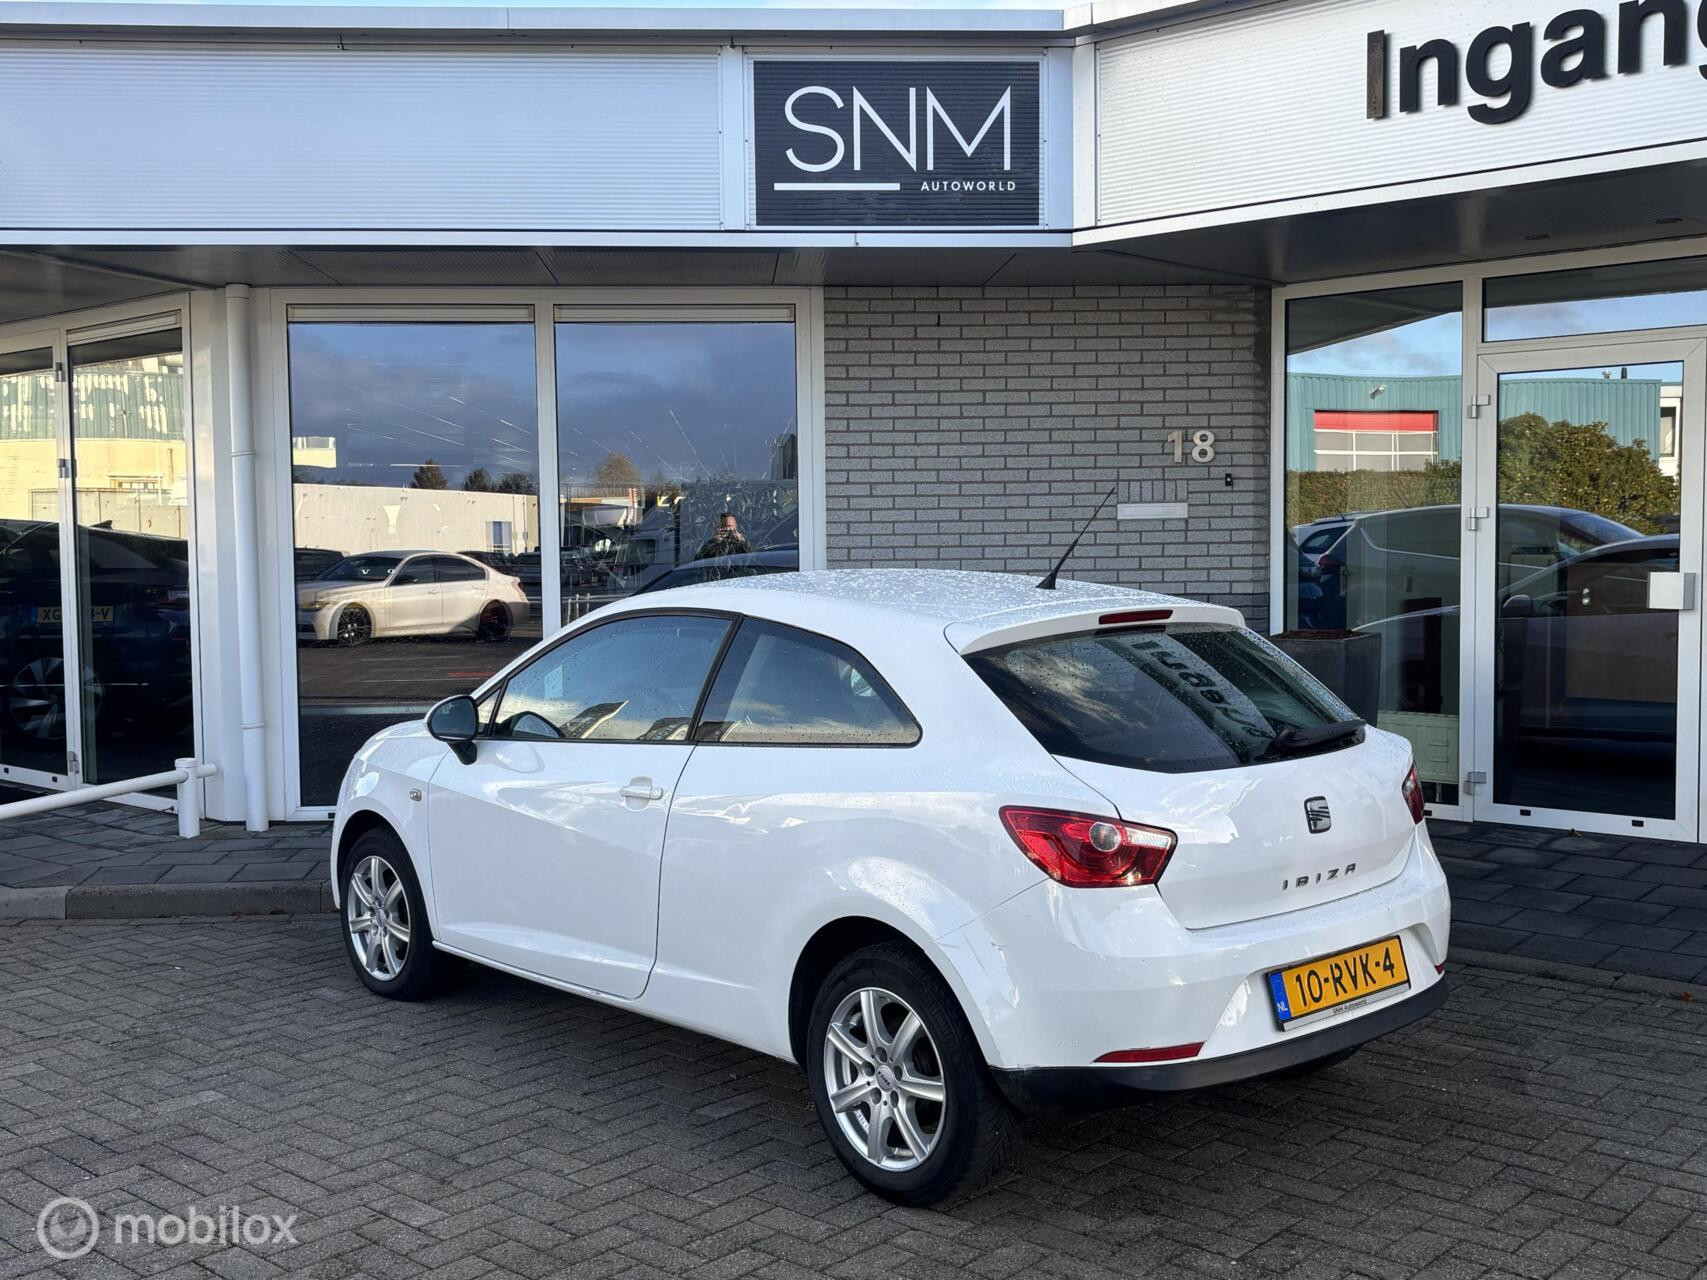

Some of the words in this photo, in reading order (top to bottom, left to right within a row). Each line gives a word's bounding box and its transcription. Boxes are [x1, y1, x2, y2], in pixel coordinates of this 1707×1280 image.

[1366, 0, 1707, 125] Ingan
[784, 85, 1011, 172] SNM
[920, 181, 1016, 191] AUTOWORLD
[1168, 430, 1215, 464] 18
[1282, 863, 1356, 890] IBIZA
[1295, 947, 1395, 1007] 10-RVK-4
[1277, 1001, 1288, 1012] NL
